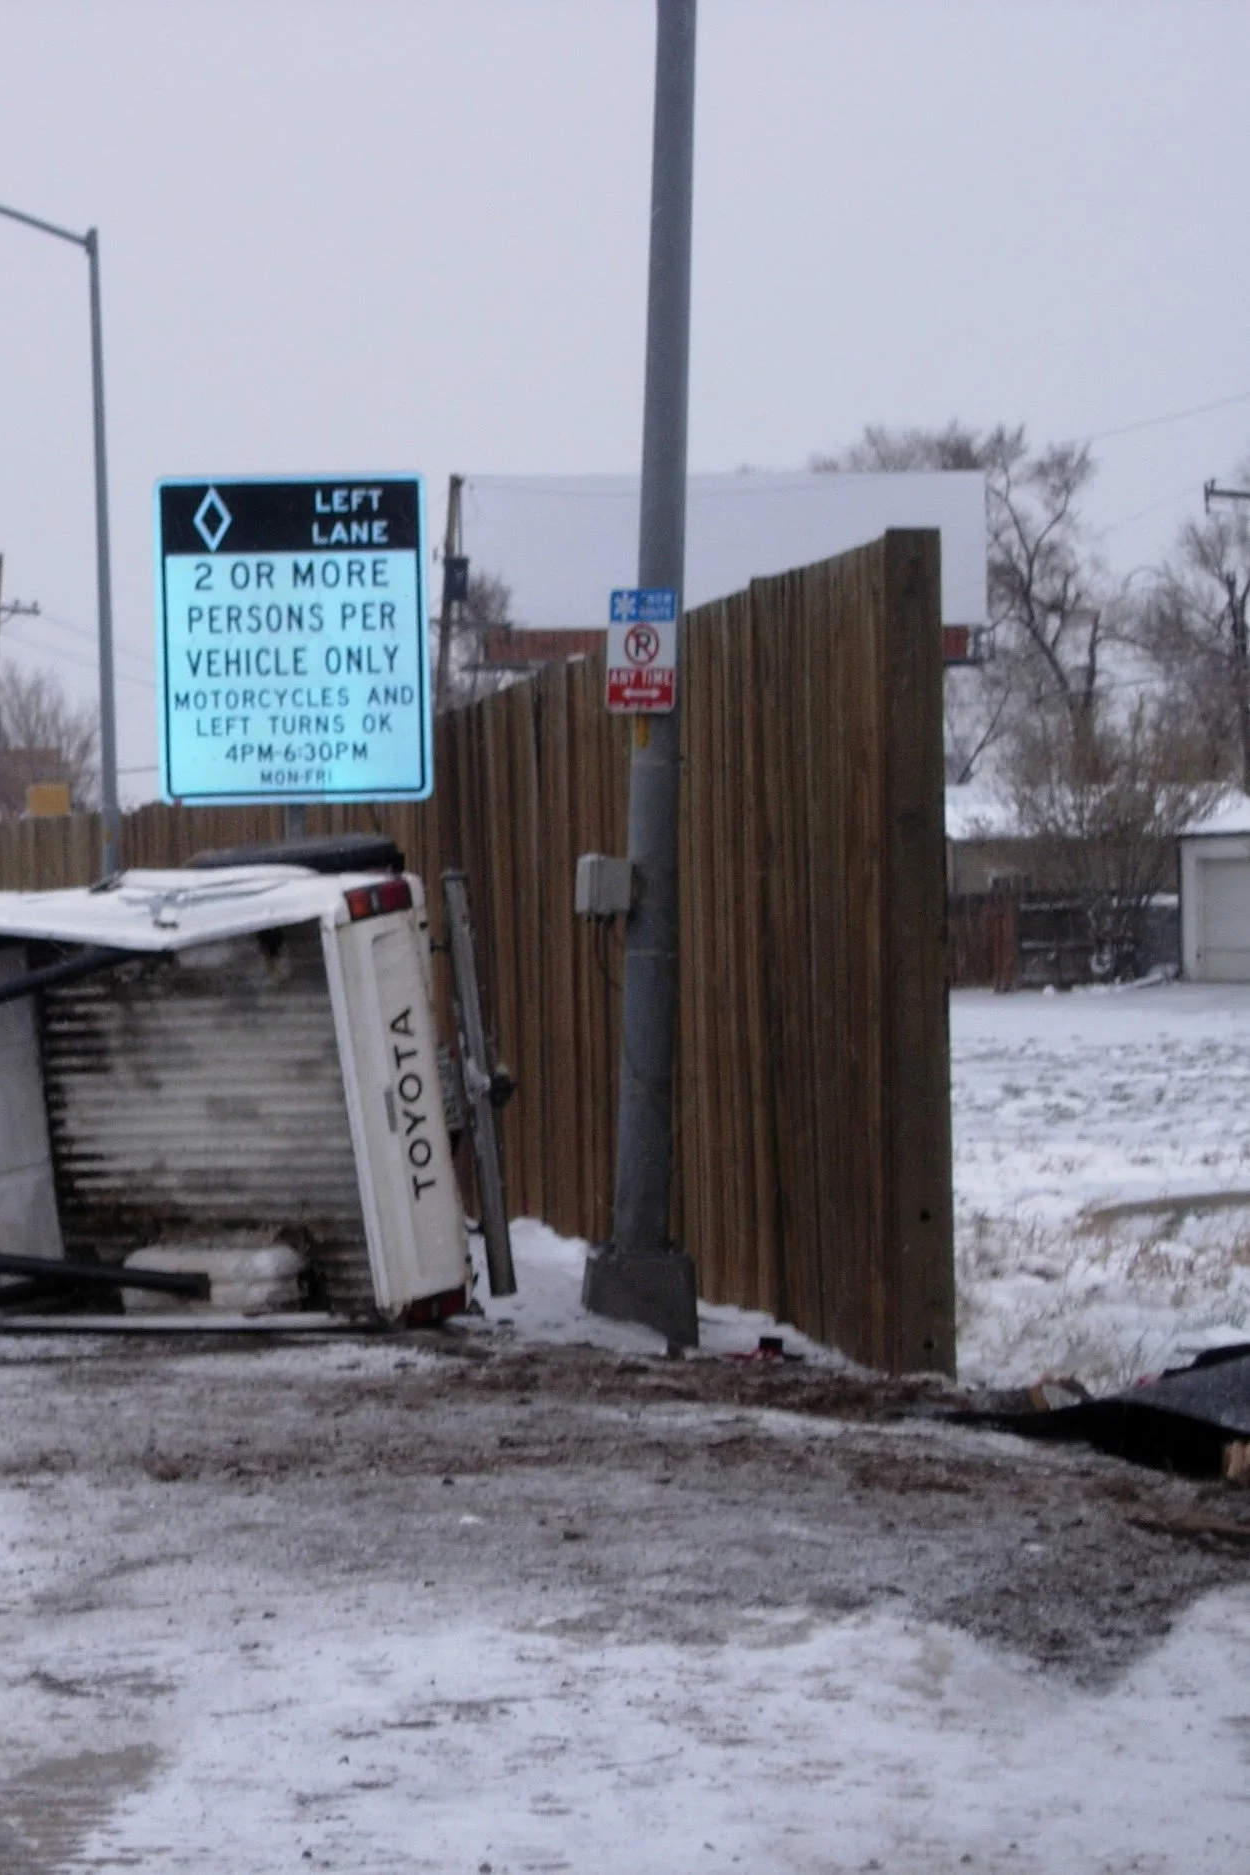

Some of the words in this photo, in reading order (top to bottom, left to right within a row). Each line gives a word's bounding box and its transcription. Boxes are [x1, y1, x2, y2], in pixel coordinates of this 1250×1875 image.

[315, 488, 383, 514] LEFT
[311, 520, 389, 545] LANE
[194, 562, 214, 591] 2
[230, 561, 275, 590] OR
[292, 558, 390, 588] MORE
[188, 603, 325, 634] PERSONS
[341, 602, 397, 632] PER
[186, 647, 308, 678] VEHICLE
[325, 646, 399, 676] ONLY
[173, 686, 350, 711] MOTORCYCLES
[367, 685, 415, 706] AND
[196, 716, 250, 737] LEFT
[269, 714, 346, 735] TURNS
[361, 713, 393, 734] OK
[391, 1007, 436, 1201] TOYOTA
